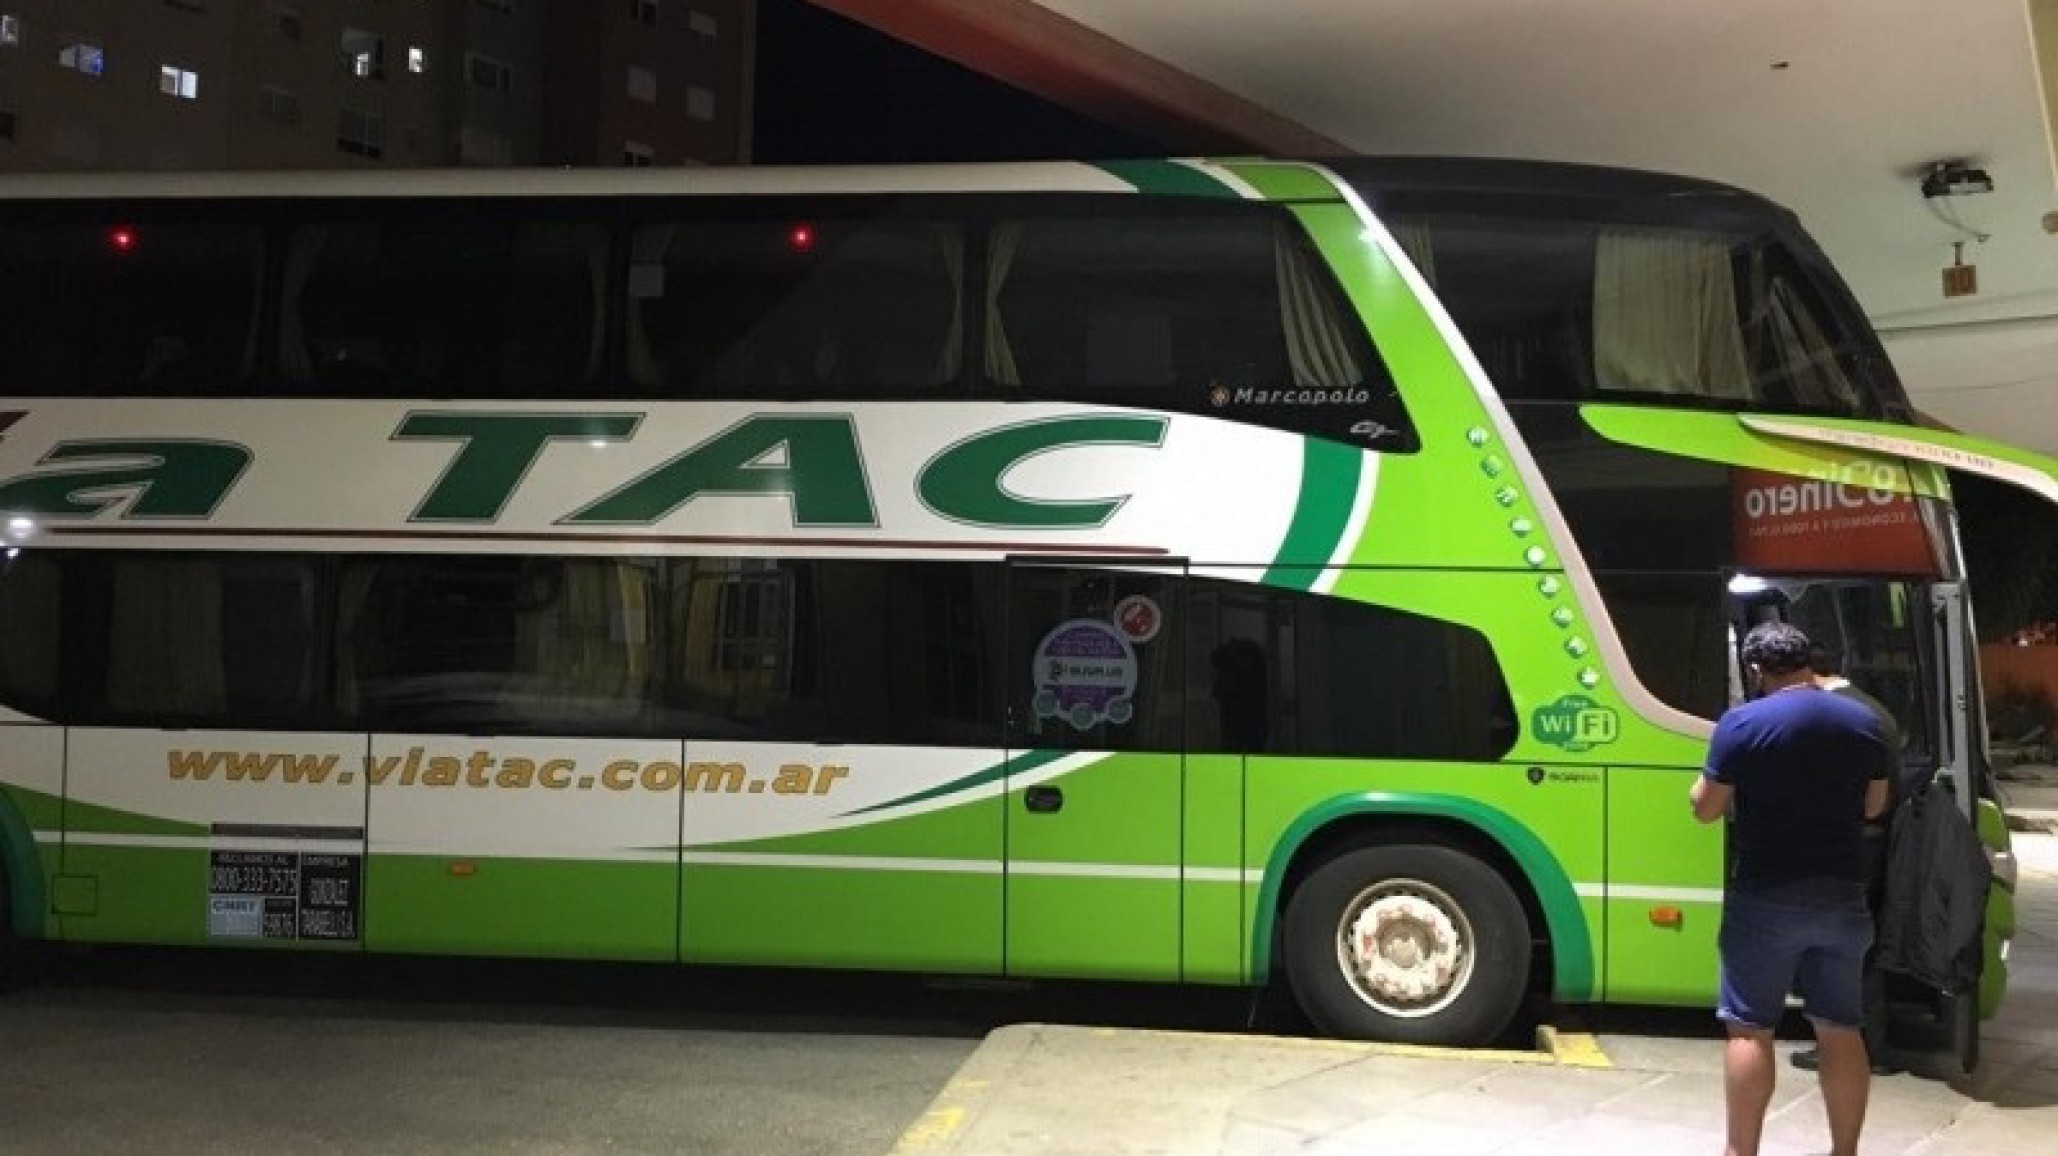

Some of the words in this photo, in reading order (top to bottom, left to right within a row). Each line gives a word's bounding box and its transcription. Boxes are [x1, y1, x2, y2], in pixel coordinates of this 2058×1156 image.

[1234, 387, 1370, 406] Marcopolo
[389, 409, 1171, 529] TAC
[168, 746, 850, 796] www.viatac.com.ar
